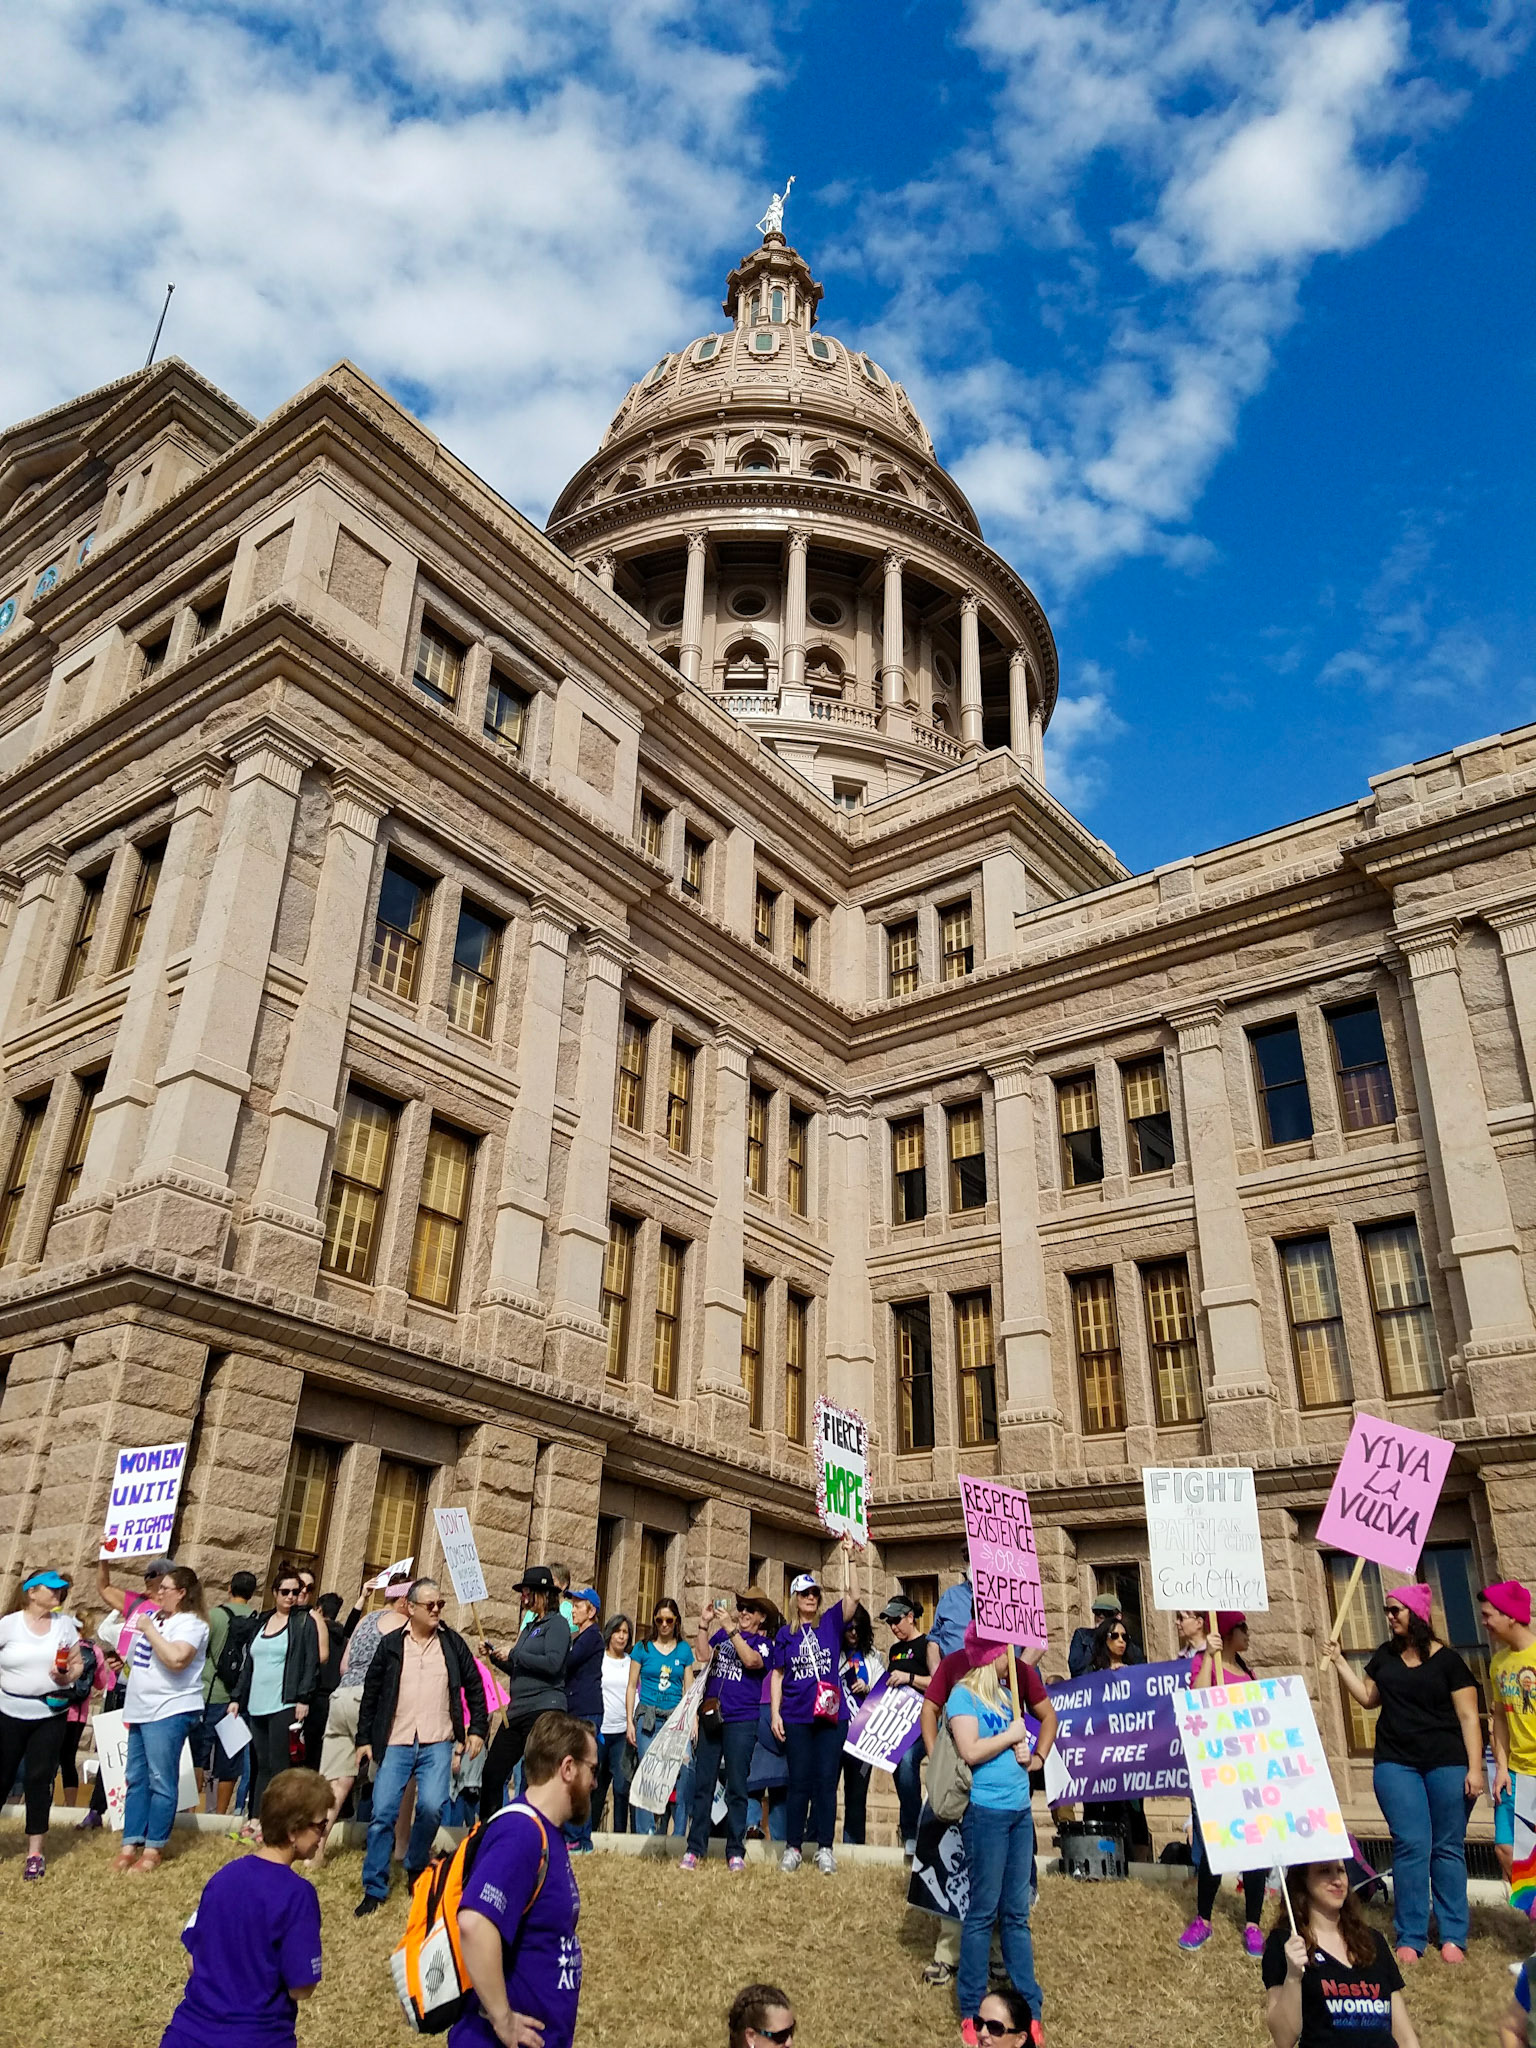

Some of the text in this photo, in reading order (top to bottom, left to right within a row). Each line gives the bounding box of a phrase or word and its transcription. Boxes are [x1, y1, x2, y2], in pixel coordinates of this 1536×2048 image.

[823, 1411, 863, 1456] FIERCE
[120, 1447, 185, 1474] WOMEN
[1360, 1432, 1430, 1483] VIVA
[112, 1478, 178, 1506] UNITE
[825, 1461, 863, 1526] HOPE
[1150, 1471, 1251, 1504] FIGHT
[1363, 1470, 1401, 1501] LA
[963, 1482, 1028, 1524] RESPECT
[1340, 1486, 1420, 1545] VULVA
[123, 1514, 174, 1536] RIGHTS
[966, 1511, 1036, 1554] EXISTENCE
[119, 1534, 163, 1553] 4 ALL
[1182, 1552, 1216, 1566] NOT
[995, 1549, 1026, 1577] OR
[976, 1570, 1040, 1607] EXPECT
[1158, 1567, 1262, 1600] Each Other
[977, 1597, 1047, 1638] RESISTANCE
[794, 1666, 831, 1681] AUSTIN
[880, 1686, 923, 1724] HEAR
[1102, 1680, 1131, 1702] AND
[1185, 1678, 1293, 1711] LIBERTY
[865, 1705, 912, 1747] OUR
[1085, 1717, 1094, 1736] A
[1109, 1710, 1155, 1734] RIGHT
[1216, 1707, 1271, 1732] AND
[855, 1730, 897, 1760] VOICE
[1062, 1748, 1086, 1767] IFE
[1101, 1743, 1148, 1763] FREE
[1197, 1728, 1304, 1760] JUSTICE
[1092, 1778, 1117, 1794] AND
[1123, 1768, 1192, 1791] VIOLENC
[1201, 1754, 1316, 1789] FOR ALL
[1242, 1785, 1281, 1809] NO
[1203, 1808, 1344, 1848] EXCEPTIONS
[1321, 1979, 1380, 2000] Nasty
[1325, 1999, 1390, 2014] women
